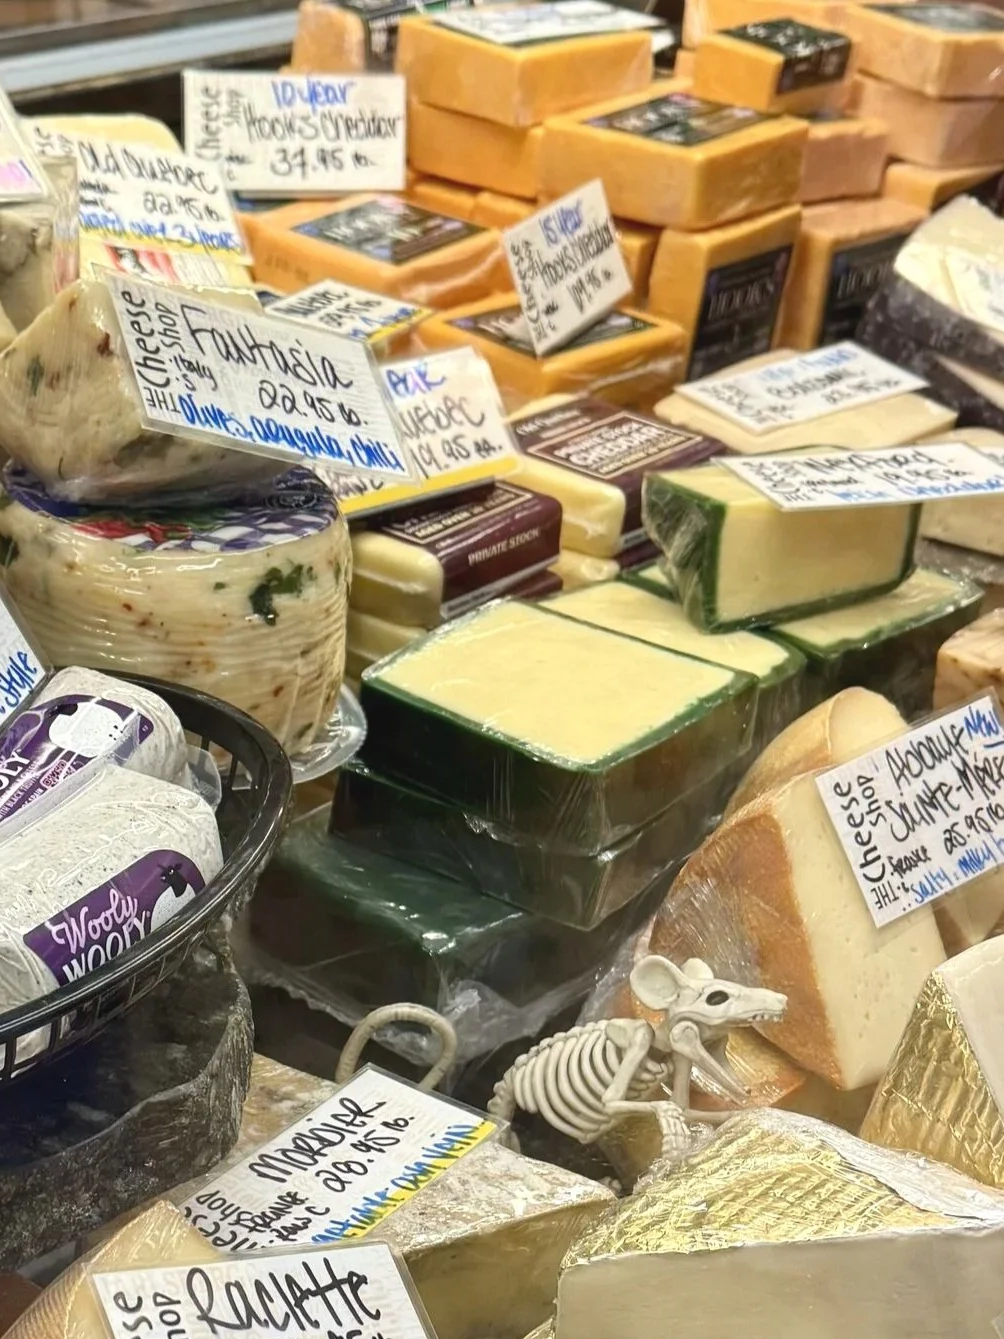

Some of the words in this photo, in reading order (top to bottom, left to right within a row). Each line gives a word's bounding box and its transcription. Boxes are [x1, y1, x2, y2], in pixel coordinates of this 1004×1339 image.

[121, 289, 171, 389] Cheese
[146, 386, 180, 415] THE
[398, 395, 486, 441] uebec
[833, 781, 886, 884] Cheese
[45, 888, 138, 954] Wooly
[870, 879, 899, 910] THE
